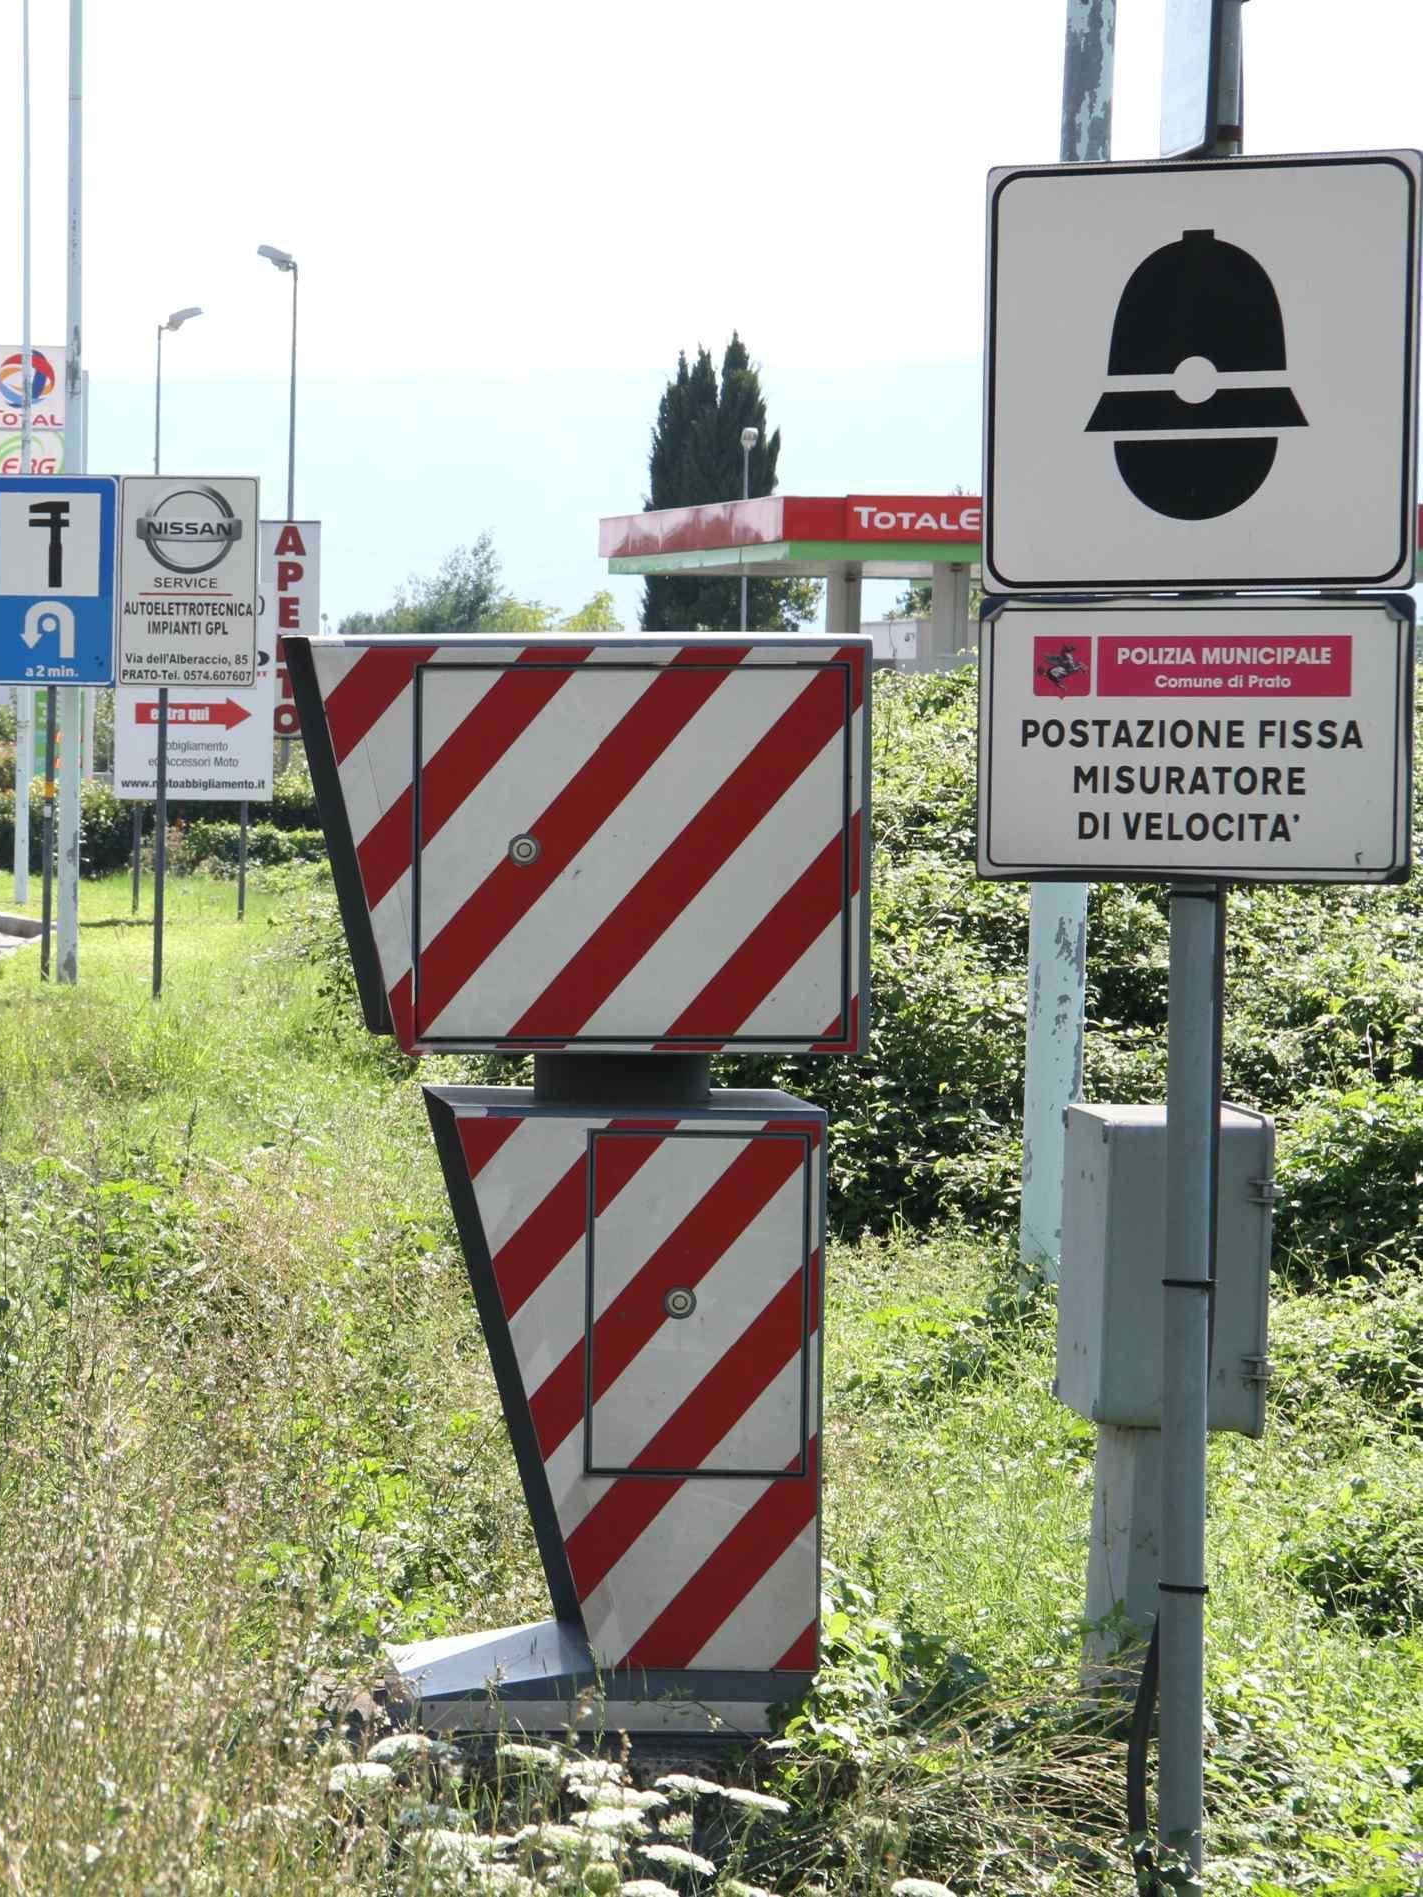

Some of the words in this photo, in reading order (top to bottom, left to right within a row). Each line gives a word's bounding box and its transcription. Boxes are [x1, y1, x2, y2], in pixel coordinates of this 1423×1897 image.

[147, 521, 233, 536] NISSAN
[154, 577, 218, 589] SERVICE
[124, 602, 253, 616] AUTOELETTROTECNICA
[147, 621, 201, 635] IMPIANTI
[205, 622, 229, 635] GPL
[125, 653, 143, 664] Via
[146, 653, 231, 666] dell'Alberaccio,
[234, 654, 248, 665] 85
[1117, 647, 1196, 665] POLIZIA
[1202, 647, 1331, 665] MUNICIPALE
[25, 667, 34, 677] a
[36, 665, 45, 677] 2
[48, 665, 79, 677] min.
[122, 669, 180, 680] PRATO-Tel.
[184, 670, 252, 681] 0574.607607
[1155, 675, 1223, 689] Comune
[1227, 675, 1244, 688] di
[1248, 675, 1291, 689] Prato
[150, 707, 186, 721] etra
[188, 706, 210, 722] qui
[1021, 719, 1245, 749] POSTAZIONE
[1259, 719, 1363, 749] FISSA
[165, 742, 228, 752] bbigliamento
[214, 757, 239, 767] Moto
[1073, 765, 1306, 796] MISURATORE
[1078, 811, 1110, 840] DI
[1122, 812, 1300, 842] VELOCITA'
